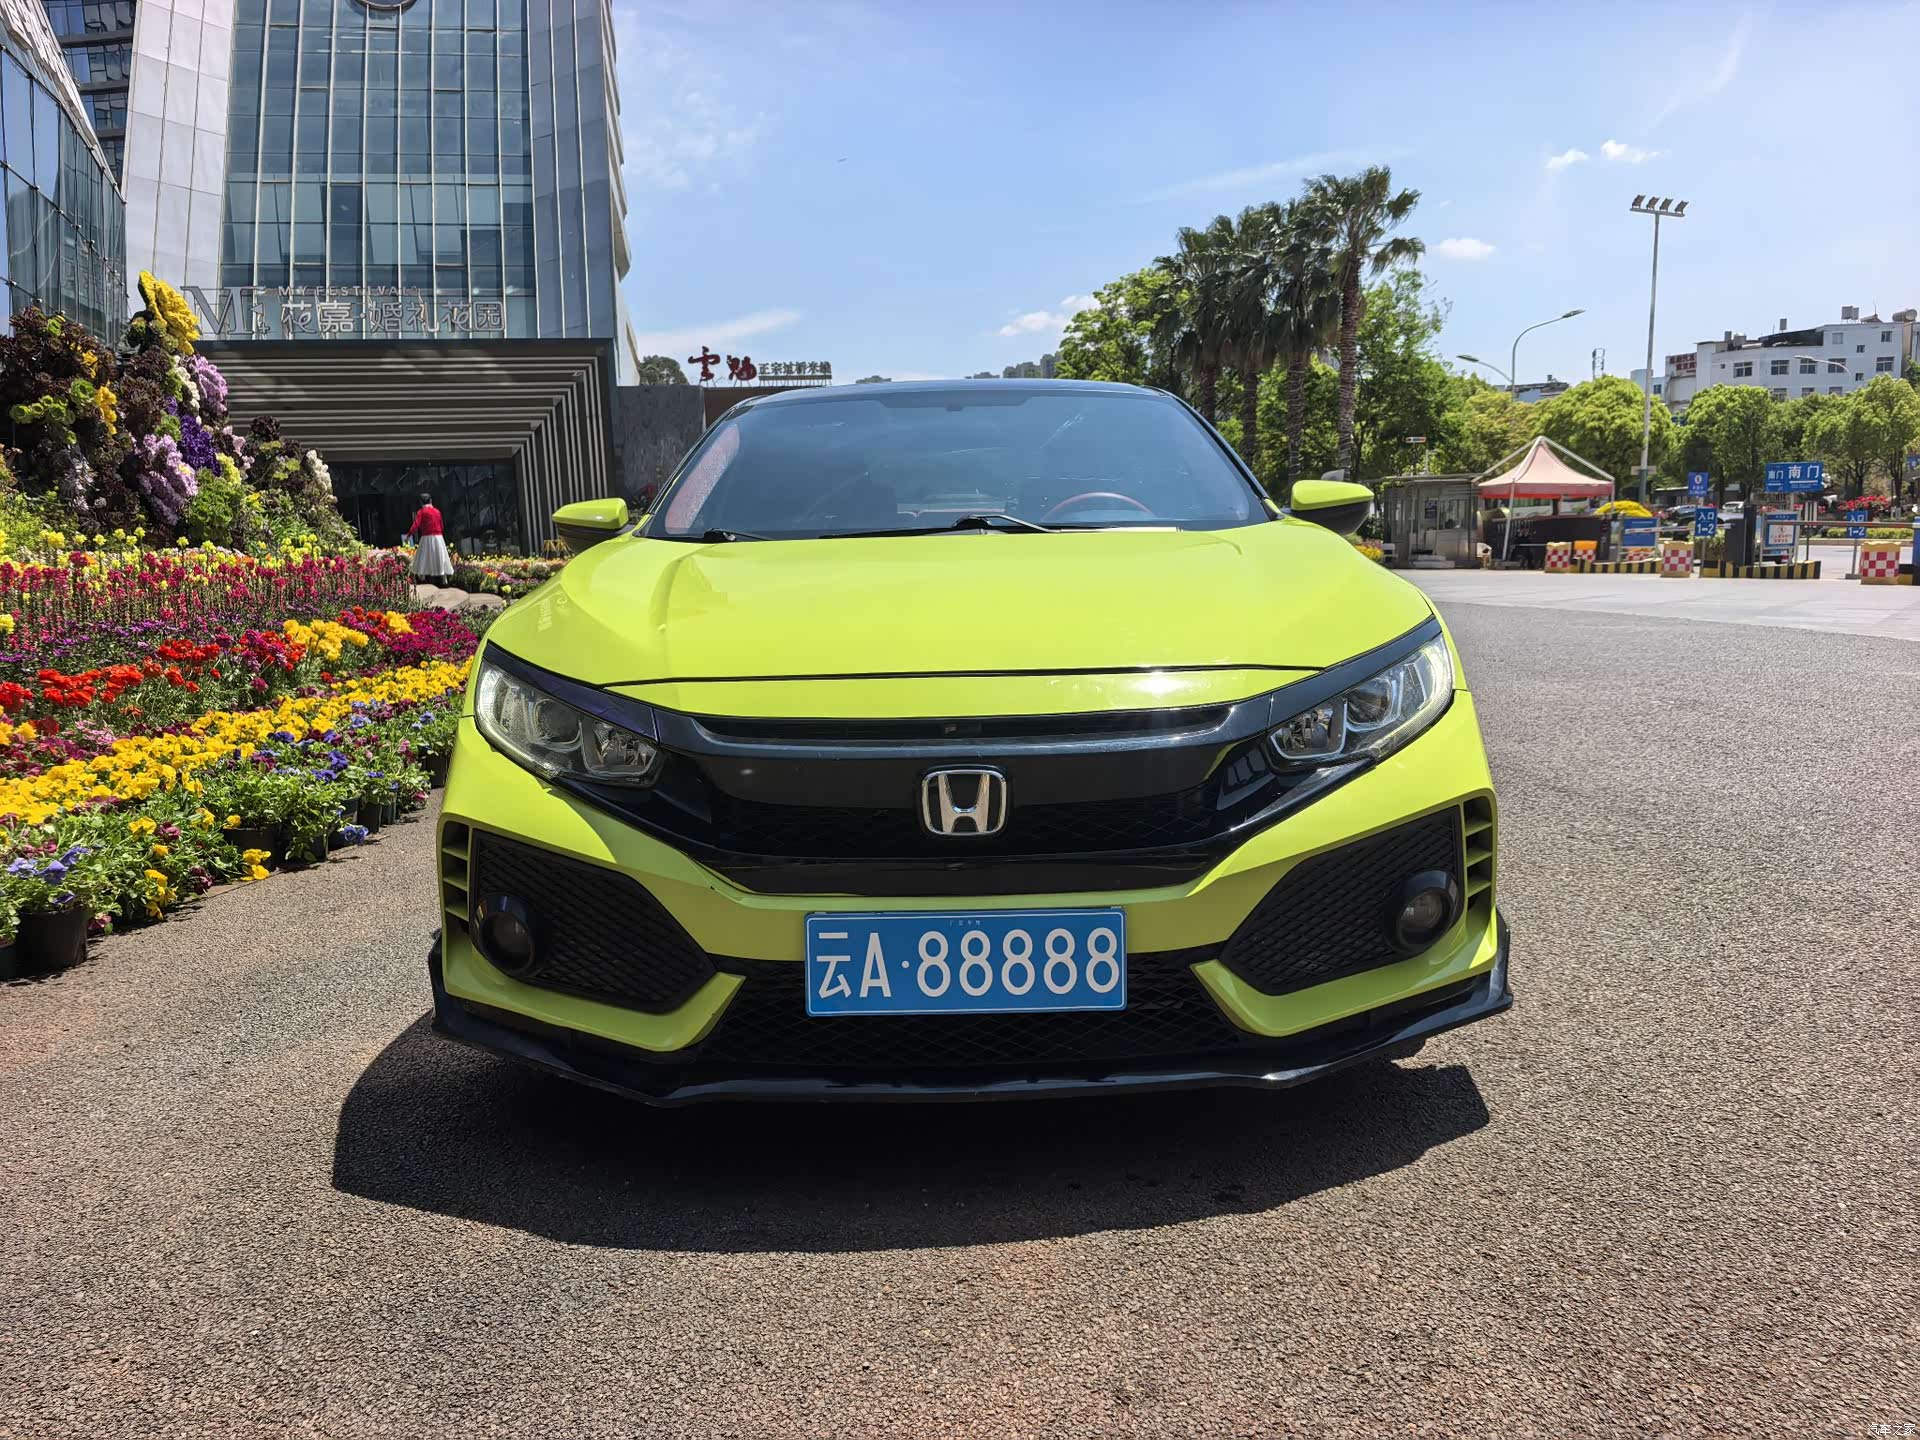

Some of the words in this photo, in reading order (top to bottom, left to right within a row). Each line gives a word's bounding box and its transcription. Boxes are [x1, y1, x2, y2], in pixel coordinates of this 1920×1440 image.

[278, 286, 307, 296] MY
[1788, 465, 1820, 479] 南门
[1698, 511, 1715, 520] 入口
[1849, 514, 1865, 522] 入口
[1697, 523, 1715, 534] 1-2
[1847, 526, 1865, 536] 1-2
